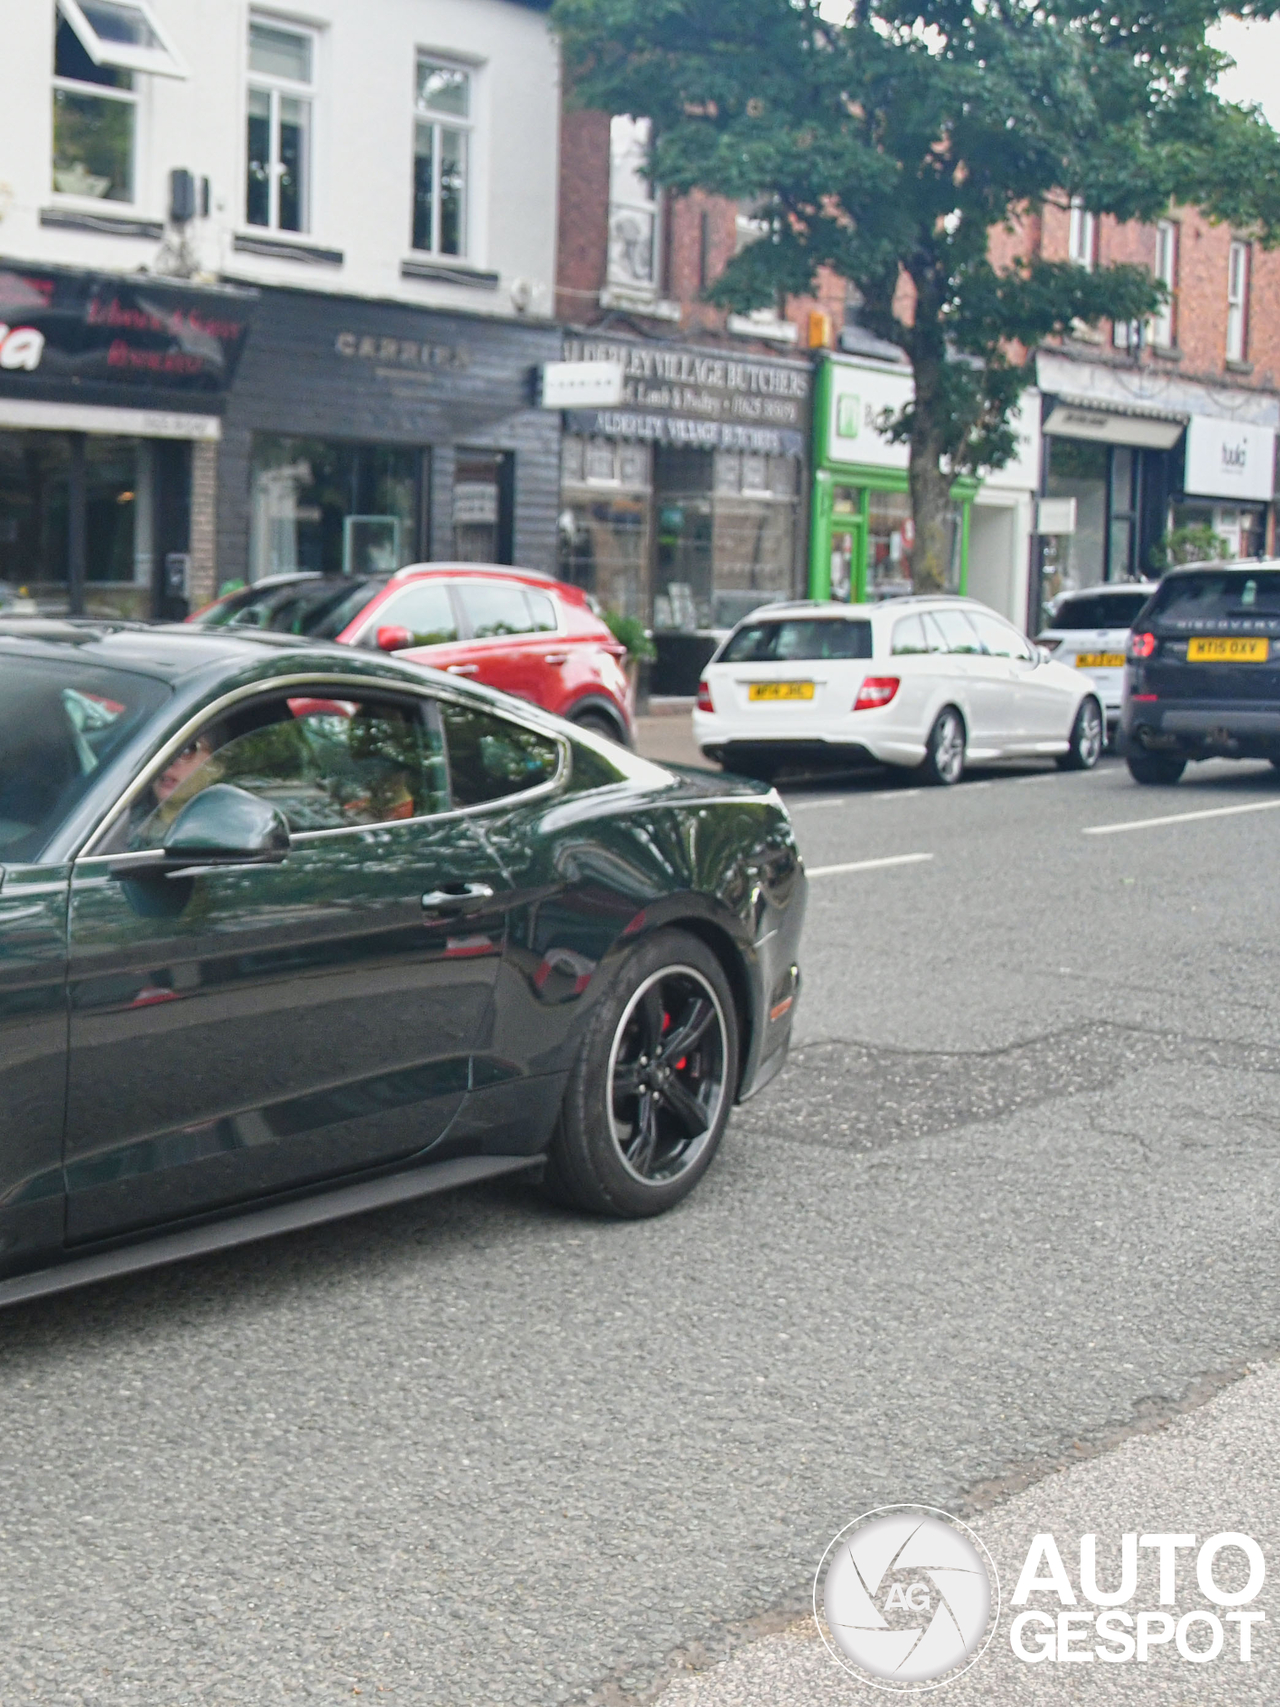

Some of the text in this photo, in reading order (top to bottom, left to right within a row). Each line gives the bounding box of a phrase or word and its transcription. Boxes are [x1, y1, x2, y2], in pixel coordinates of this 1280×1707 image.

[655, 353, 726, 390] VILLAGE
[727, 361, 809, 399] BUTCHERS
[1176, 618, 1280, 631] DISCOVERY
